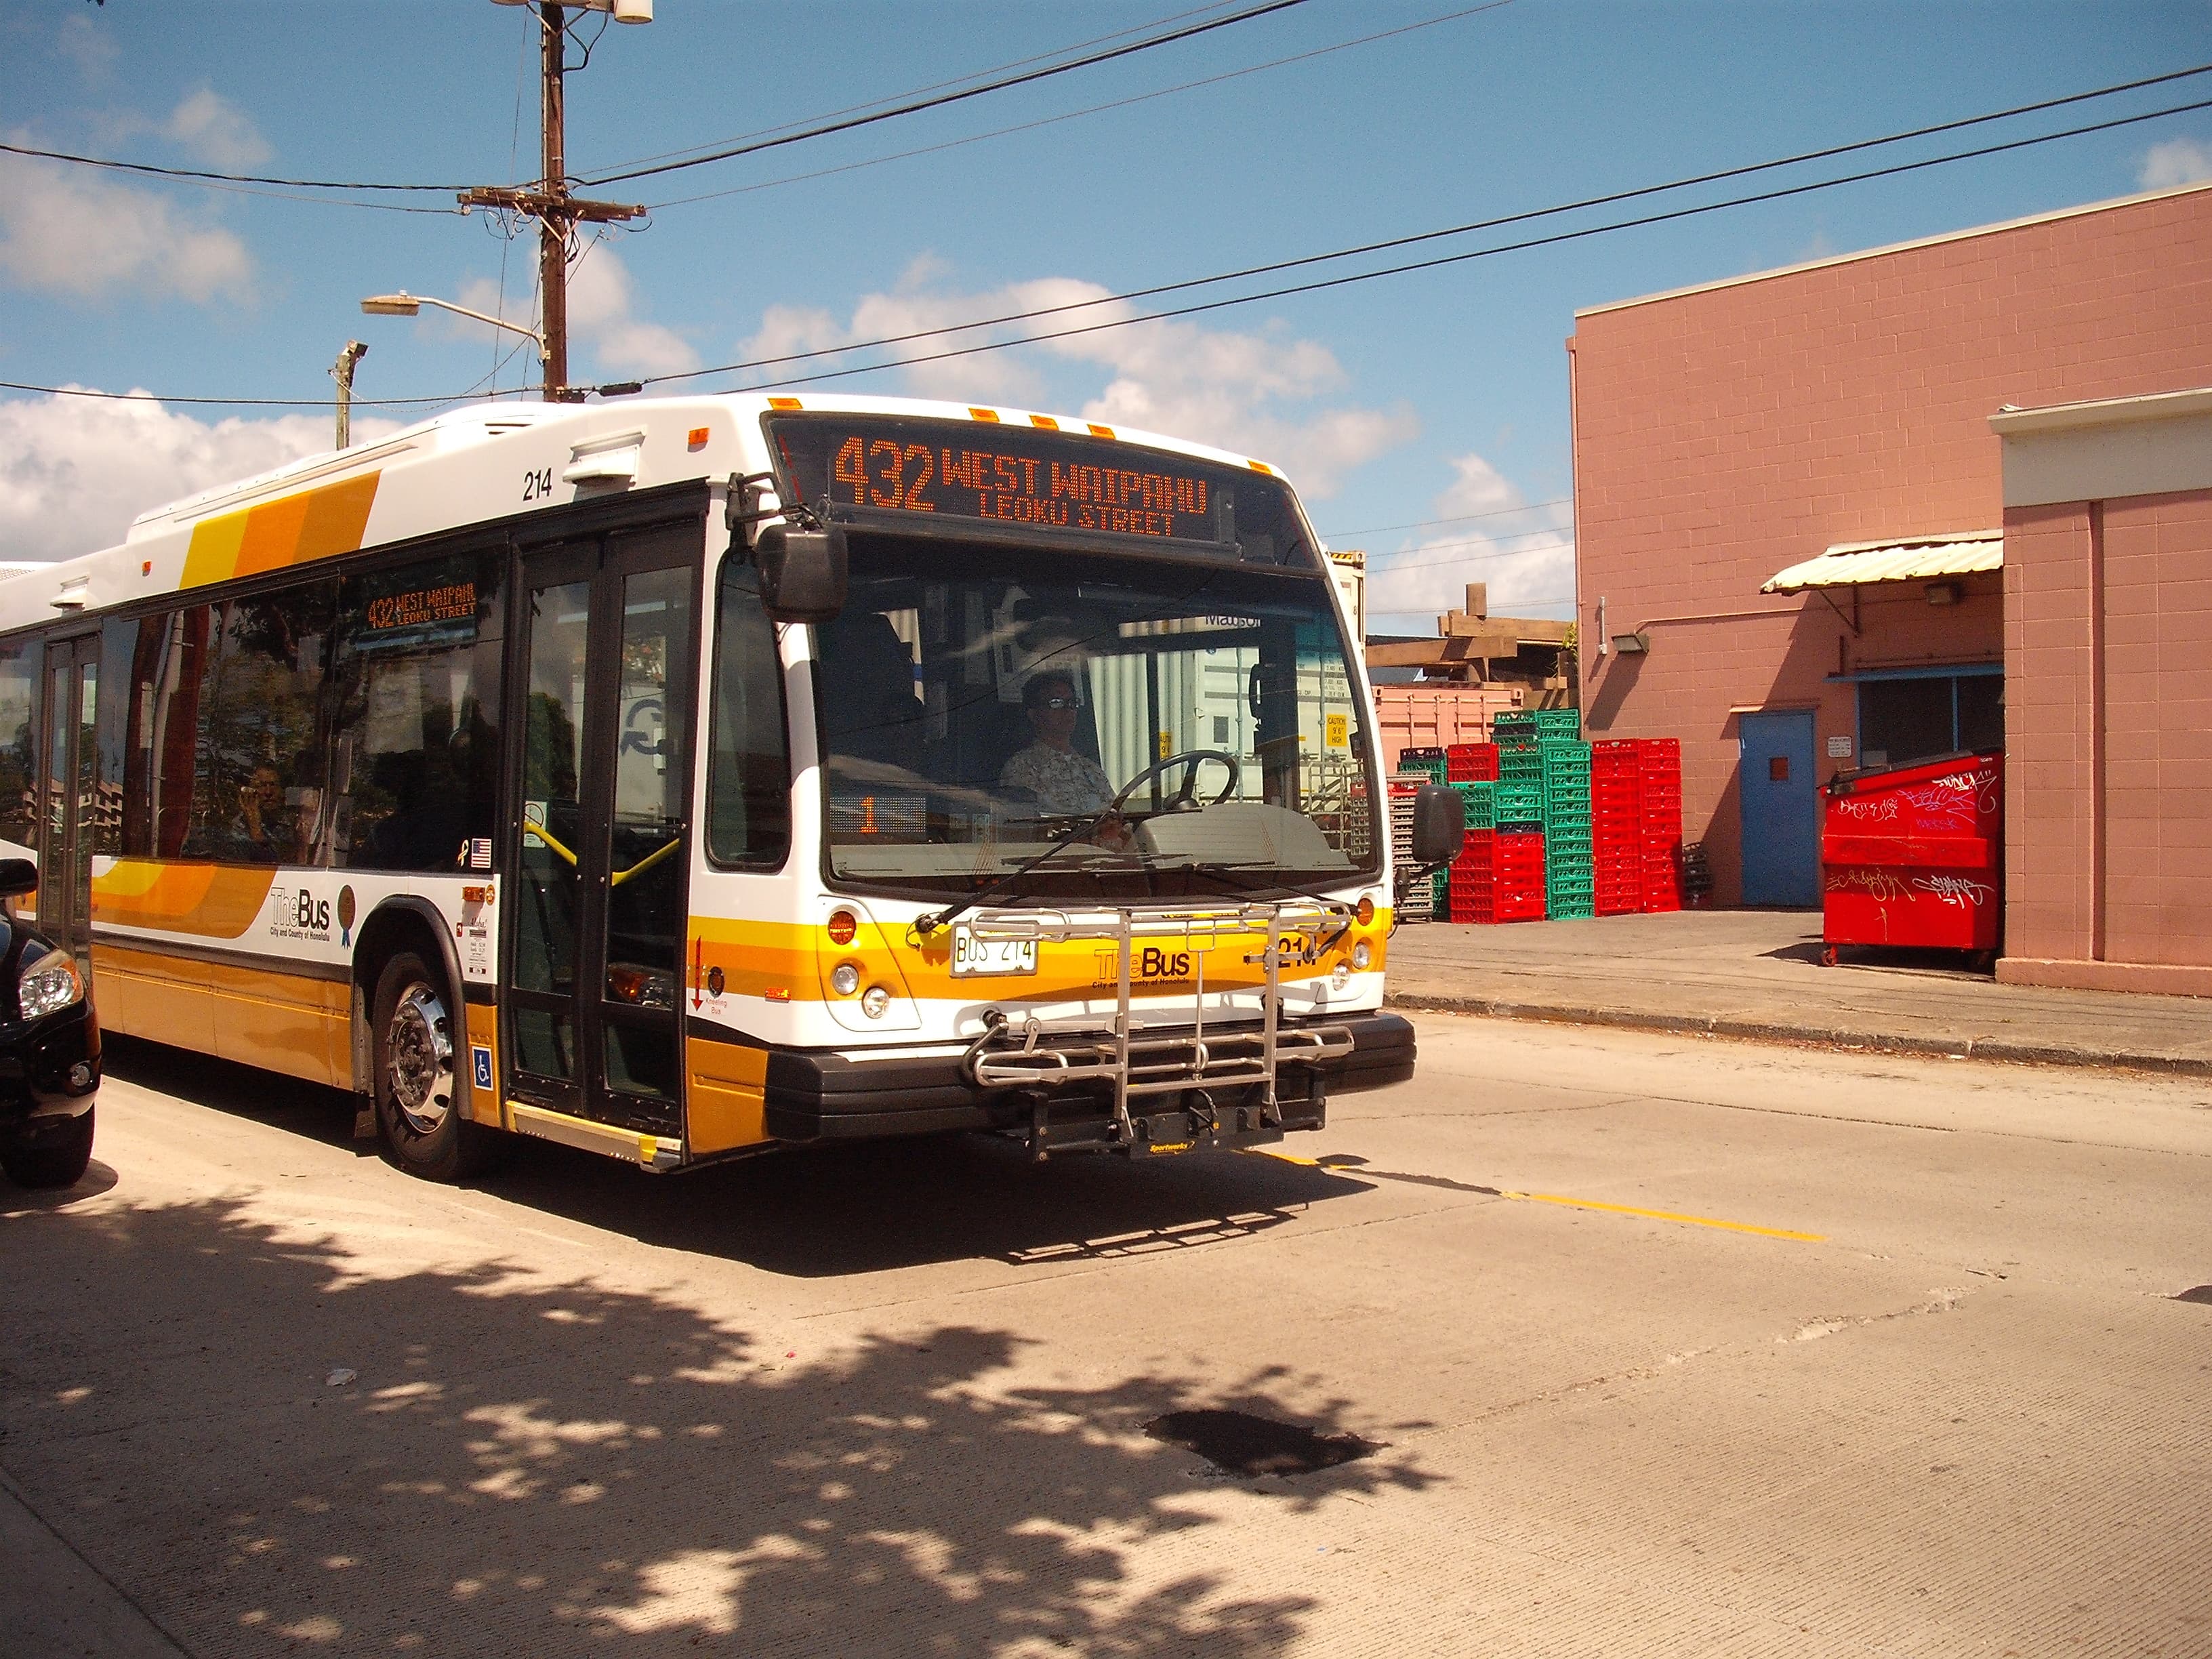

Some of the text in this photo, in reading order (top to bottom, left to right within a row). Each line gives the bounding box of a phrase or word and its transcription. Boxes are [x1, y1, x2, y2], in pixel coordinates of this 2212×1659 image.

[523, 467, 552, 501] 214
[836, 437, 1207, 514] 432 WEST WAIPAHU
[981, 493, 1175, 537] LEOKU STREET
[368, 598, 394, 629] 432
[396, 592, 424, 612] WEST
[435, 602, 476, 619] STREET
[861, 796, 878, 834] 1
[270, 887, 330, 930] TheBus
[957, 937, 1031, 962] BUS 214
[1160, 977, 1189, 985] Honolulu
